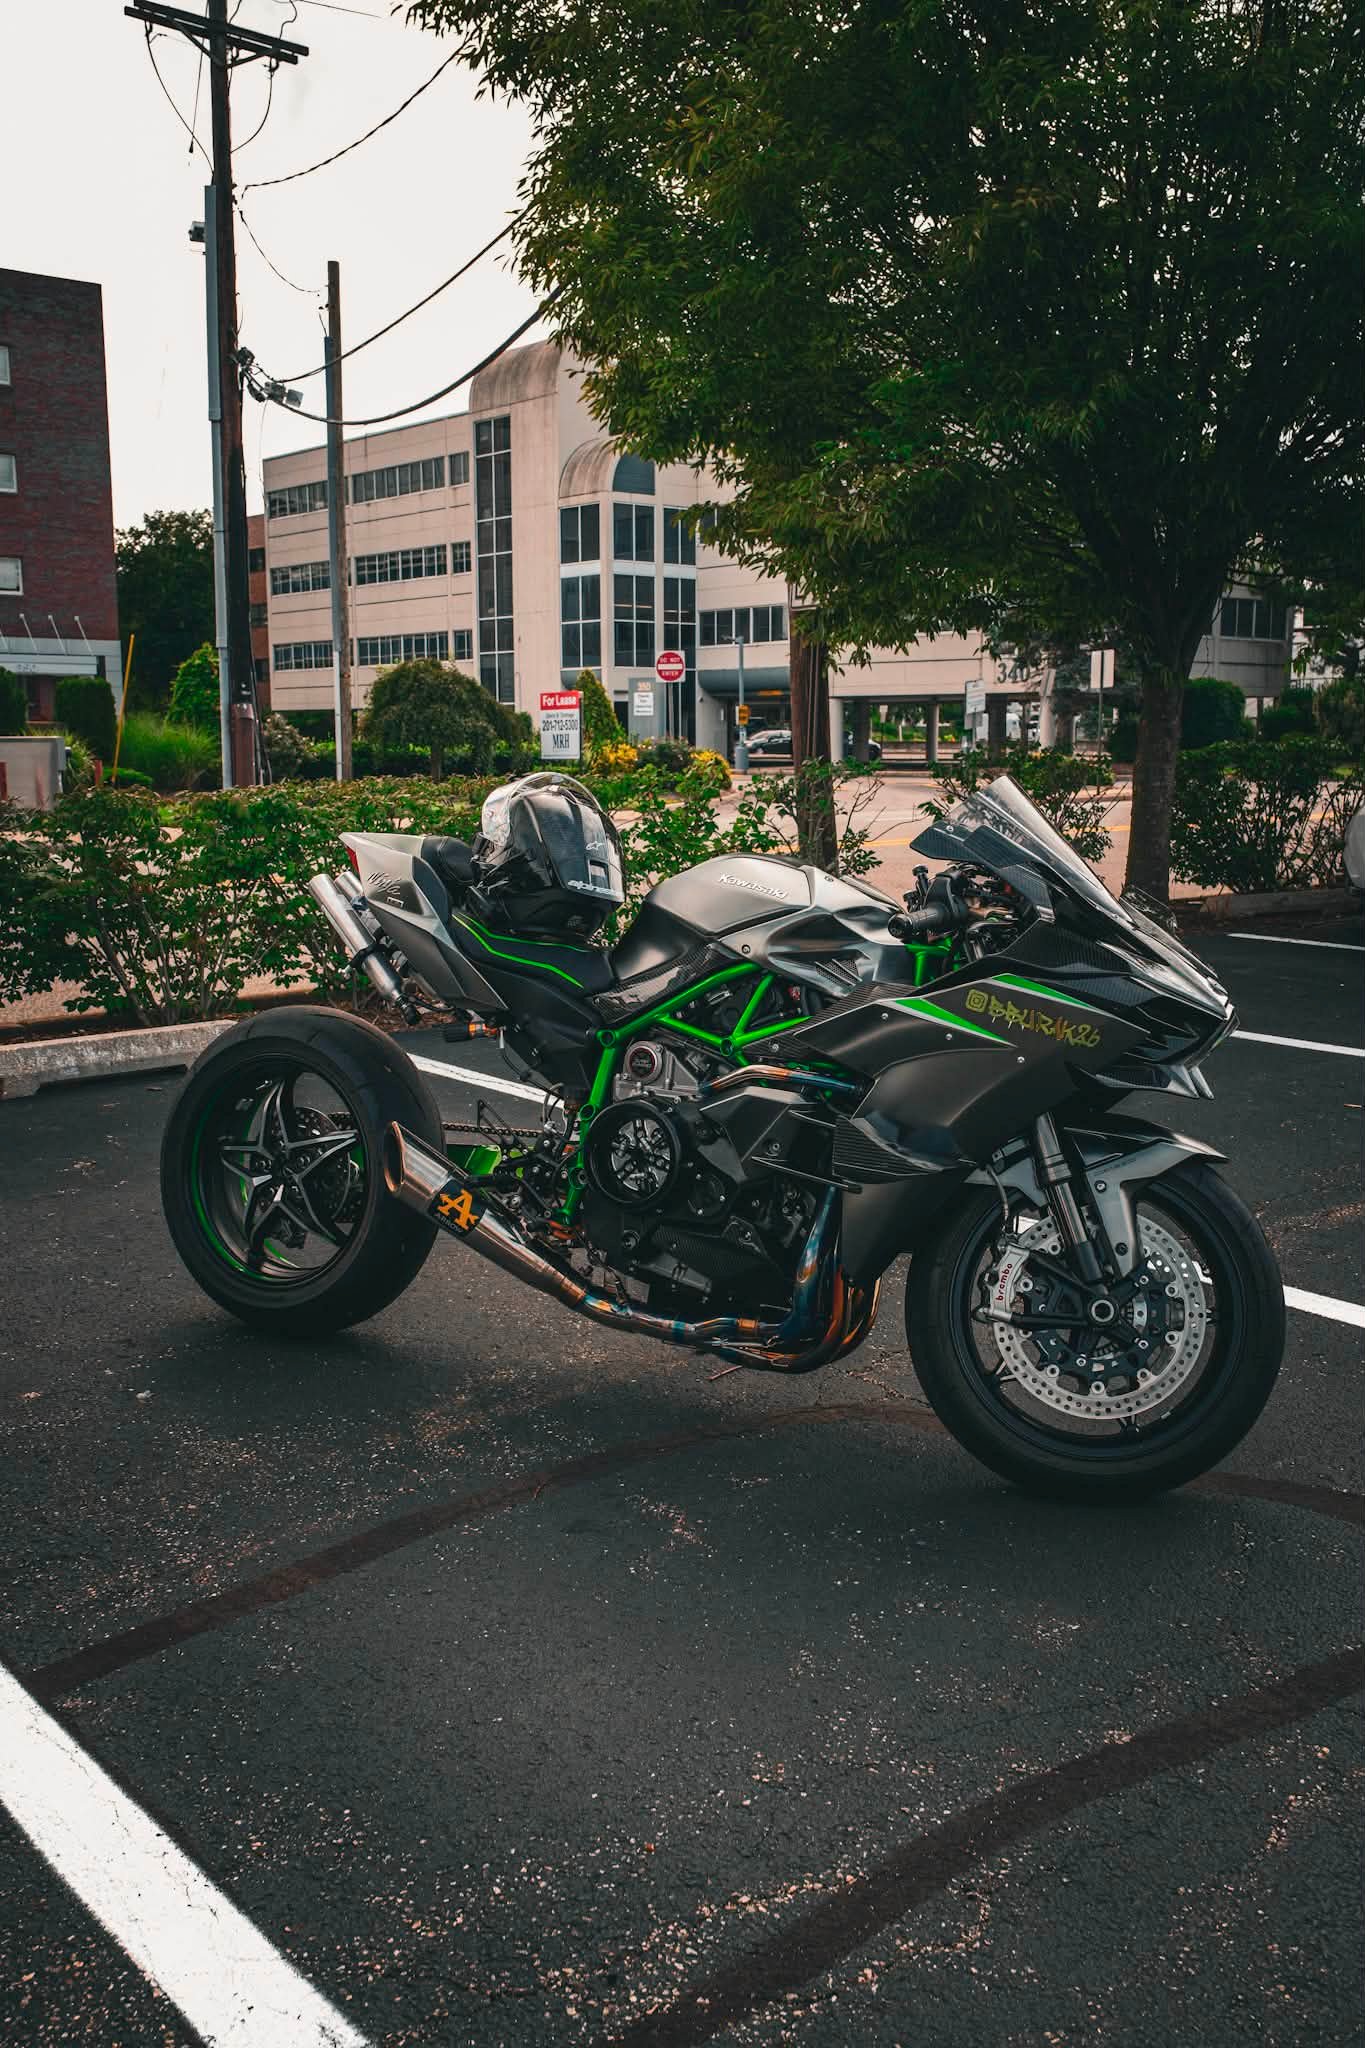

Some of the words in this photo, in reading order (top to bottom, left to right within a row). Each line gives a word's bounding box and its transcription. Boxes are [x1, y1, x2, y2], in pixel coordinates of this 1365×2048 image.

[997, 662, 1031, 684] 340
[542, 695, 555, 707] For
[555, 694, 577, 706] Lease
[552, 733, 570, 749] MRH
[719, 873, 789, 900] Kawasaki
[995, 1263, 1013, 1301] brembo
